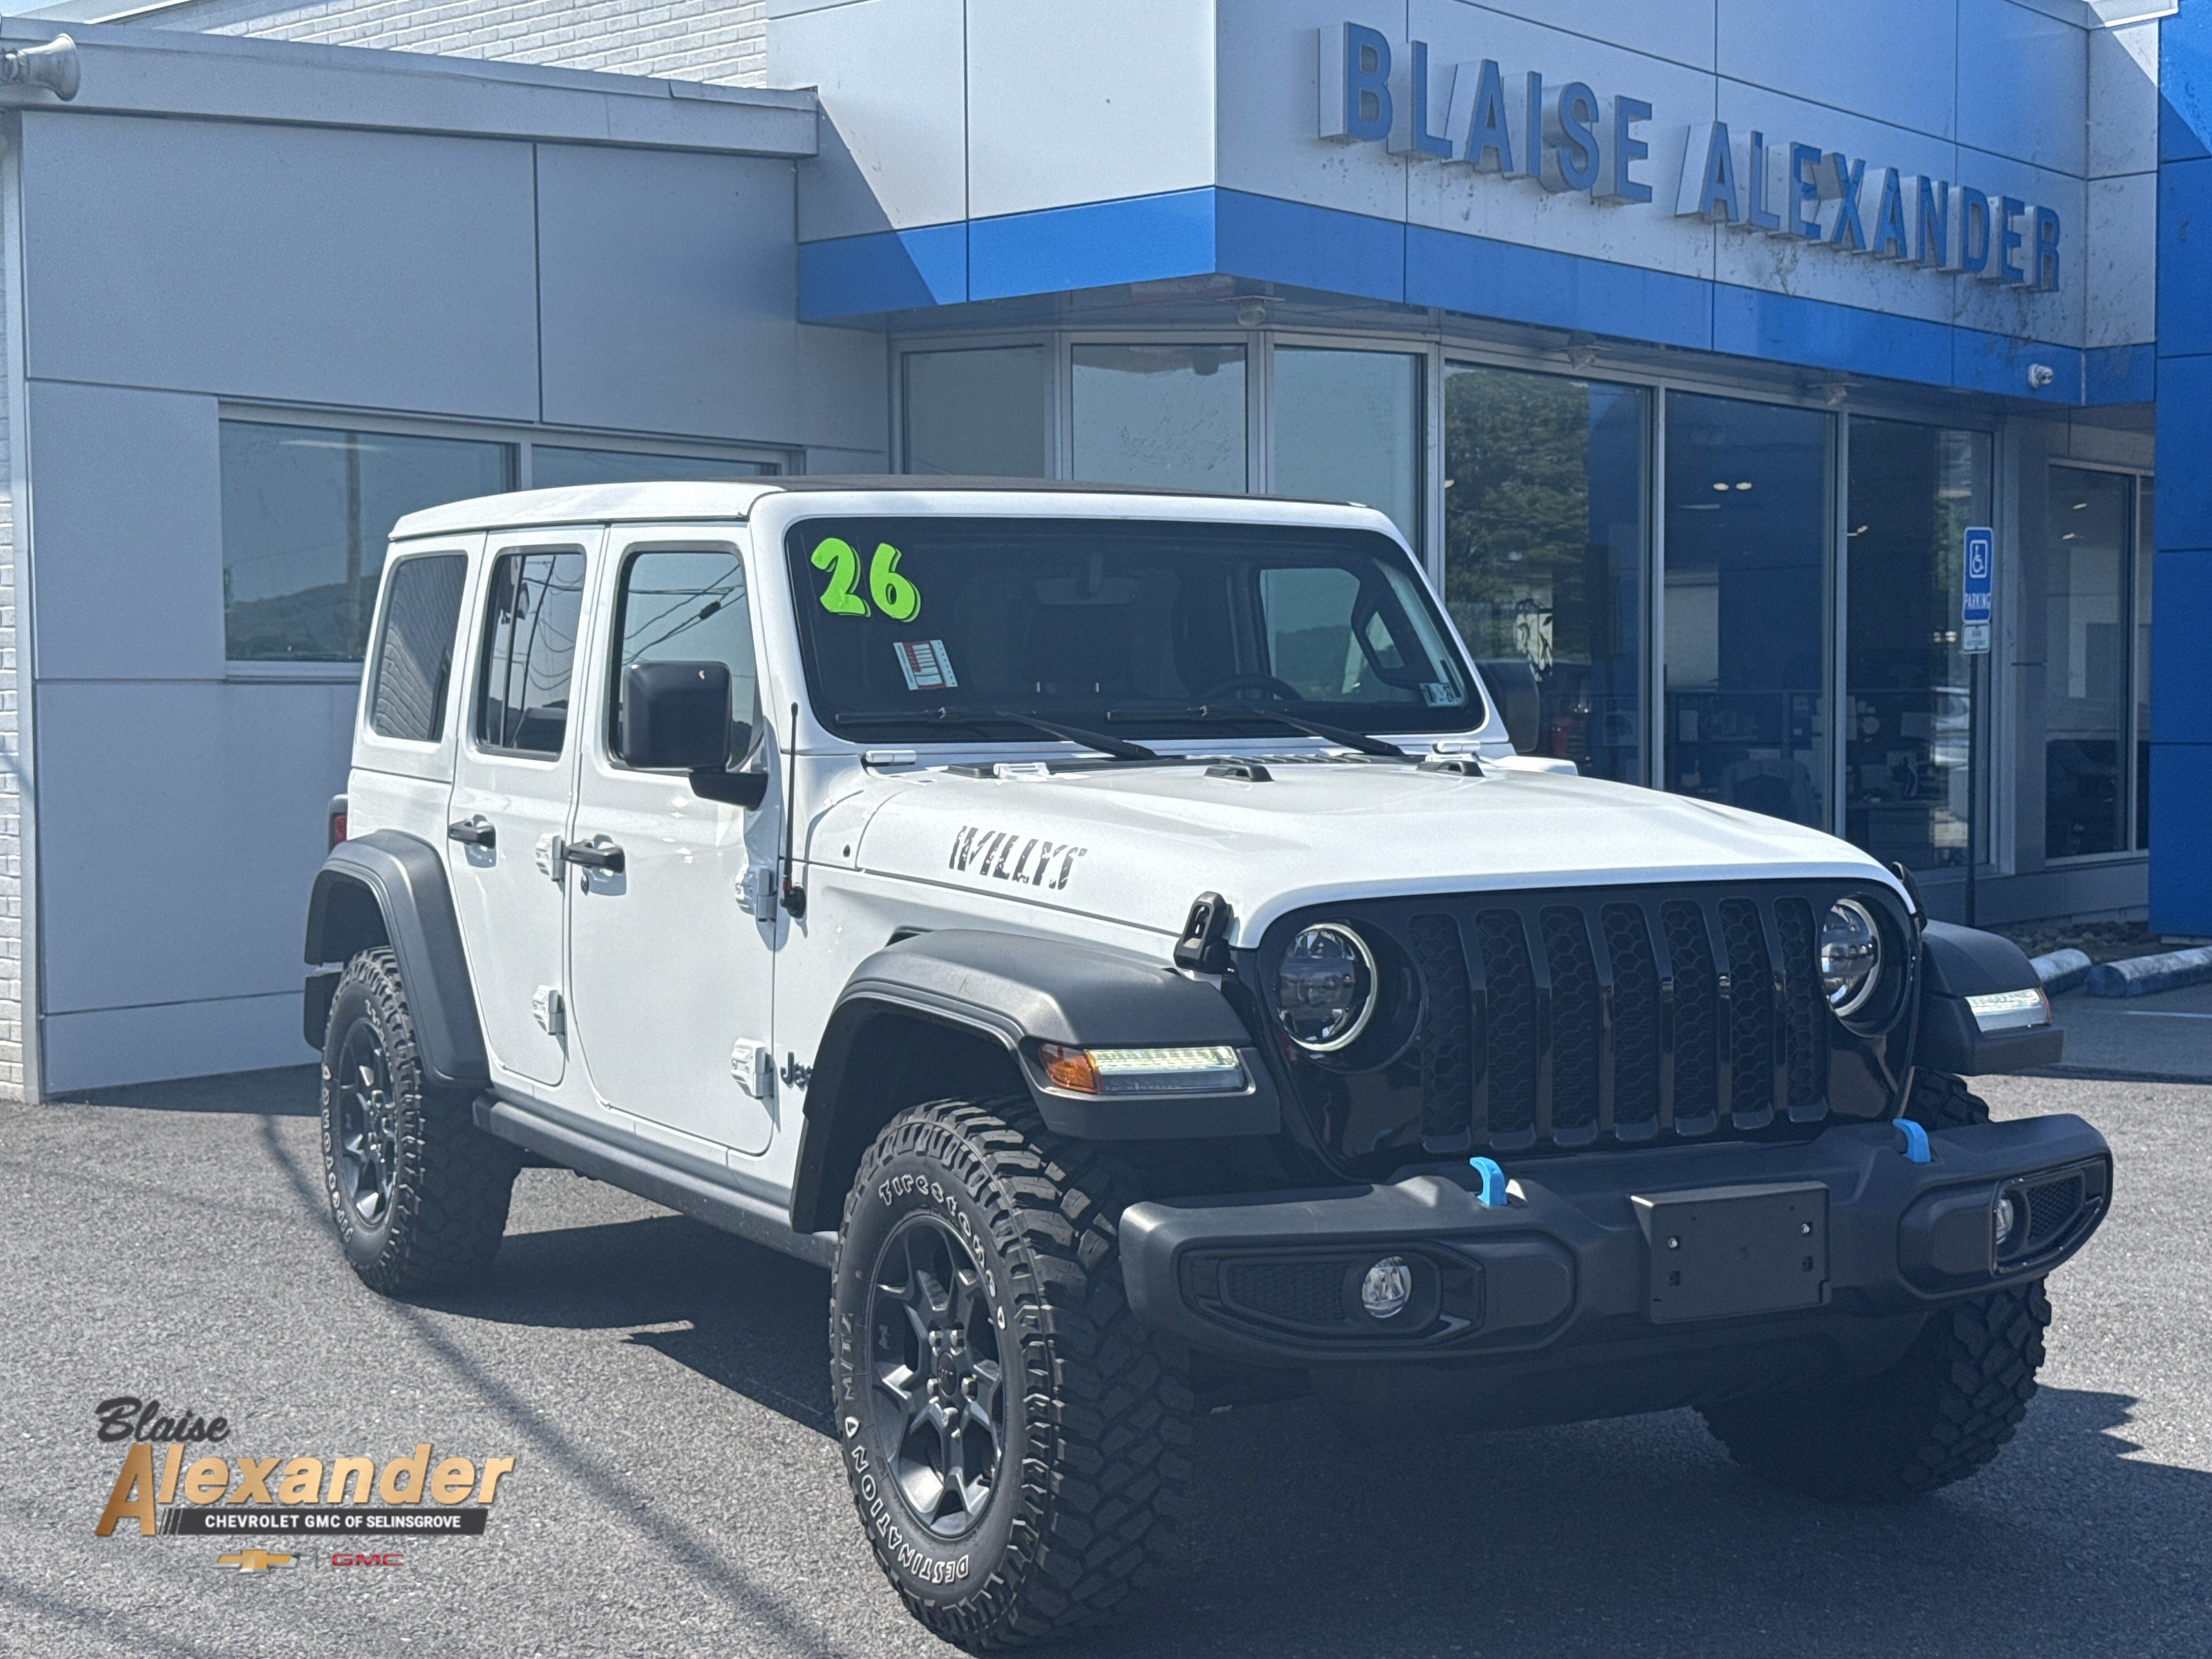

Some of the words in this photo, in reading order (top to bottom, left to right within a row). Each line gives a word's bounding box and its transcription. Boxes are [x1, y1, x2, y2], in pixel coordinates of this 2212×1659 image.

[1342, 21, 1652, 204] BLAISE
[1697, 121, 2061, 292] ALEXANDER
[810, 537, 921, 623] 26
[1963, 592, 1991, 611] PARKING
[949, 825, 1088, 890] WILLYS
[851, 1444, 970, 1584] DESTINATION
